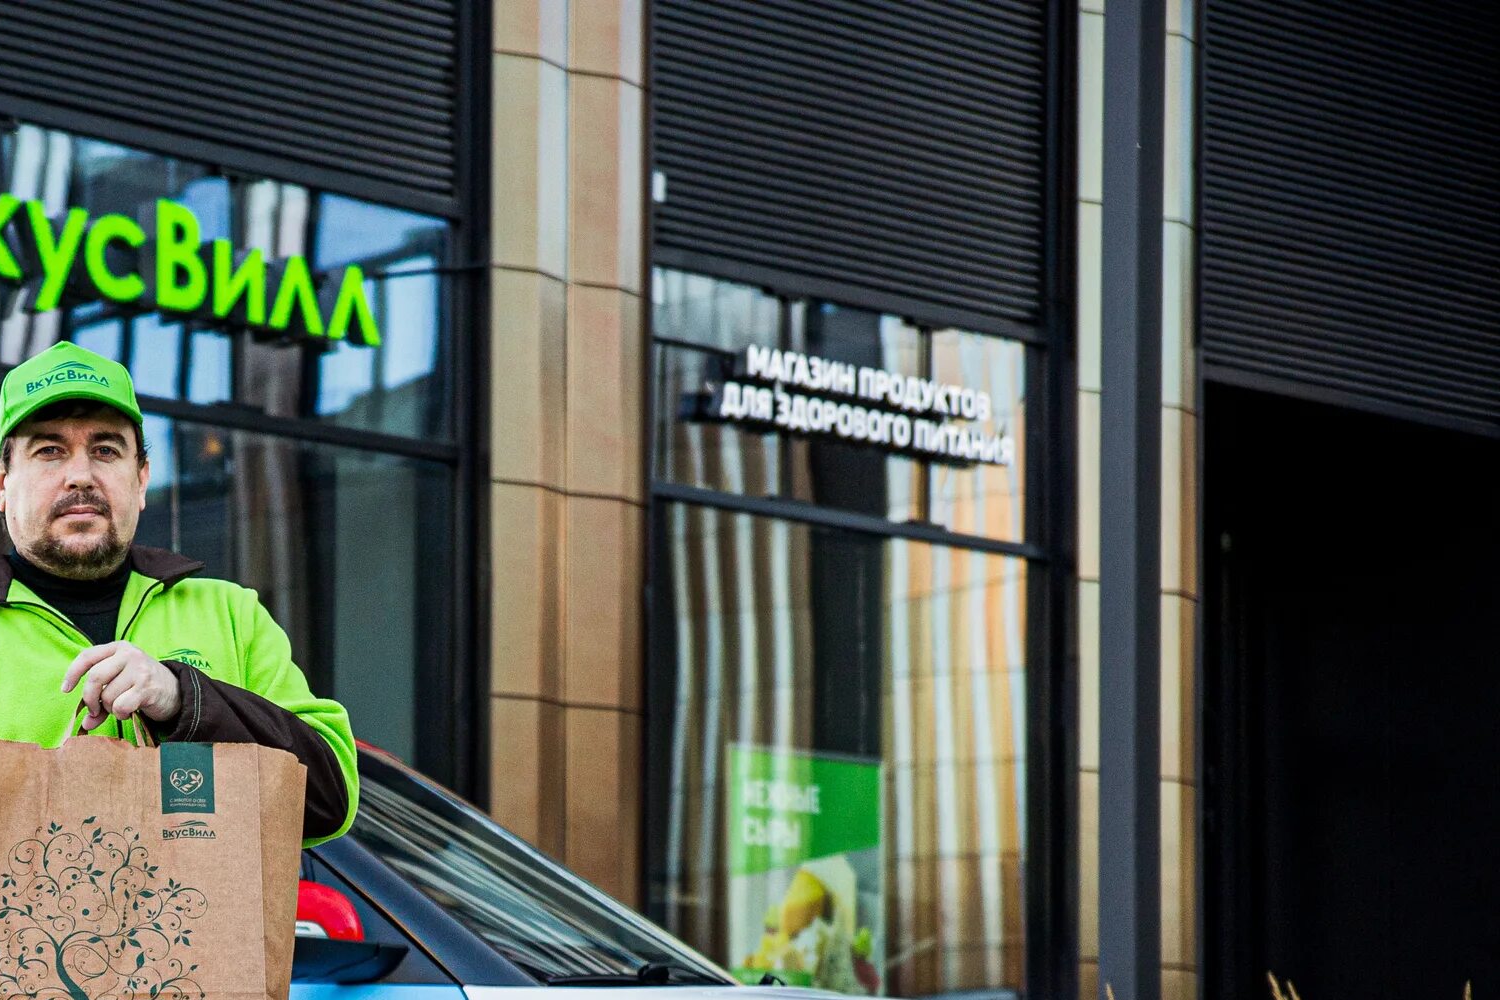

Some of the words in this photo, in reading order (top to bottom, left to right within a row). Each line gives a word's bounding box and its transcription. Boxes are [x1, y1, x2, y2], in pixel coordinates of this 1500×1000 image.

[721, 381, 773, 420] ДЛЯ
[776, 391, 911, 443] ЗДОРОВОГО
[913, 418, 1015, 466] ПИТАНИЯ
[746, 343, 856, 396] МАГАЗИН
[858, 366, 991, 422] ПРОДУКТОВ
